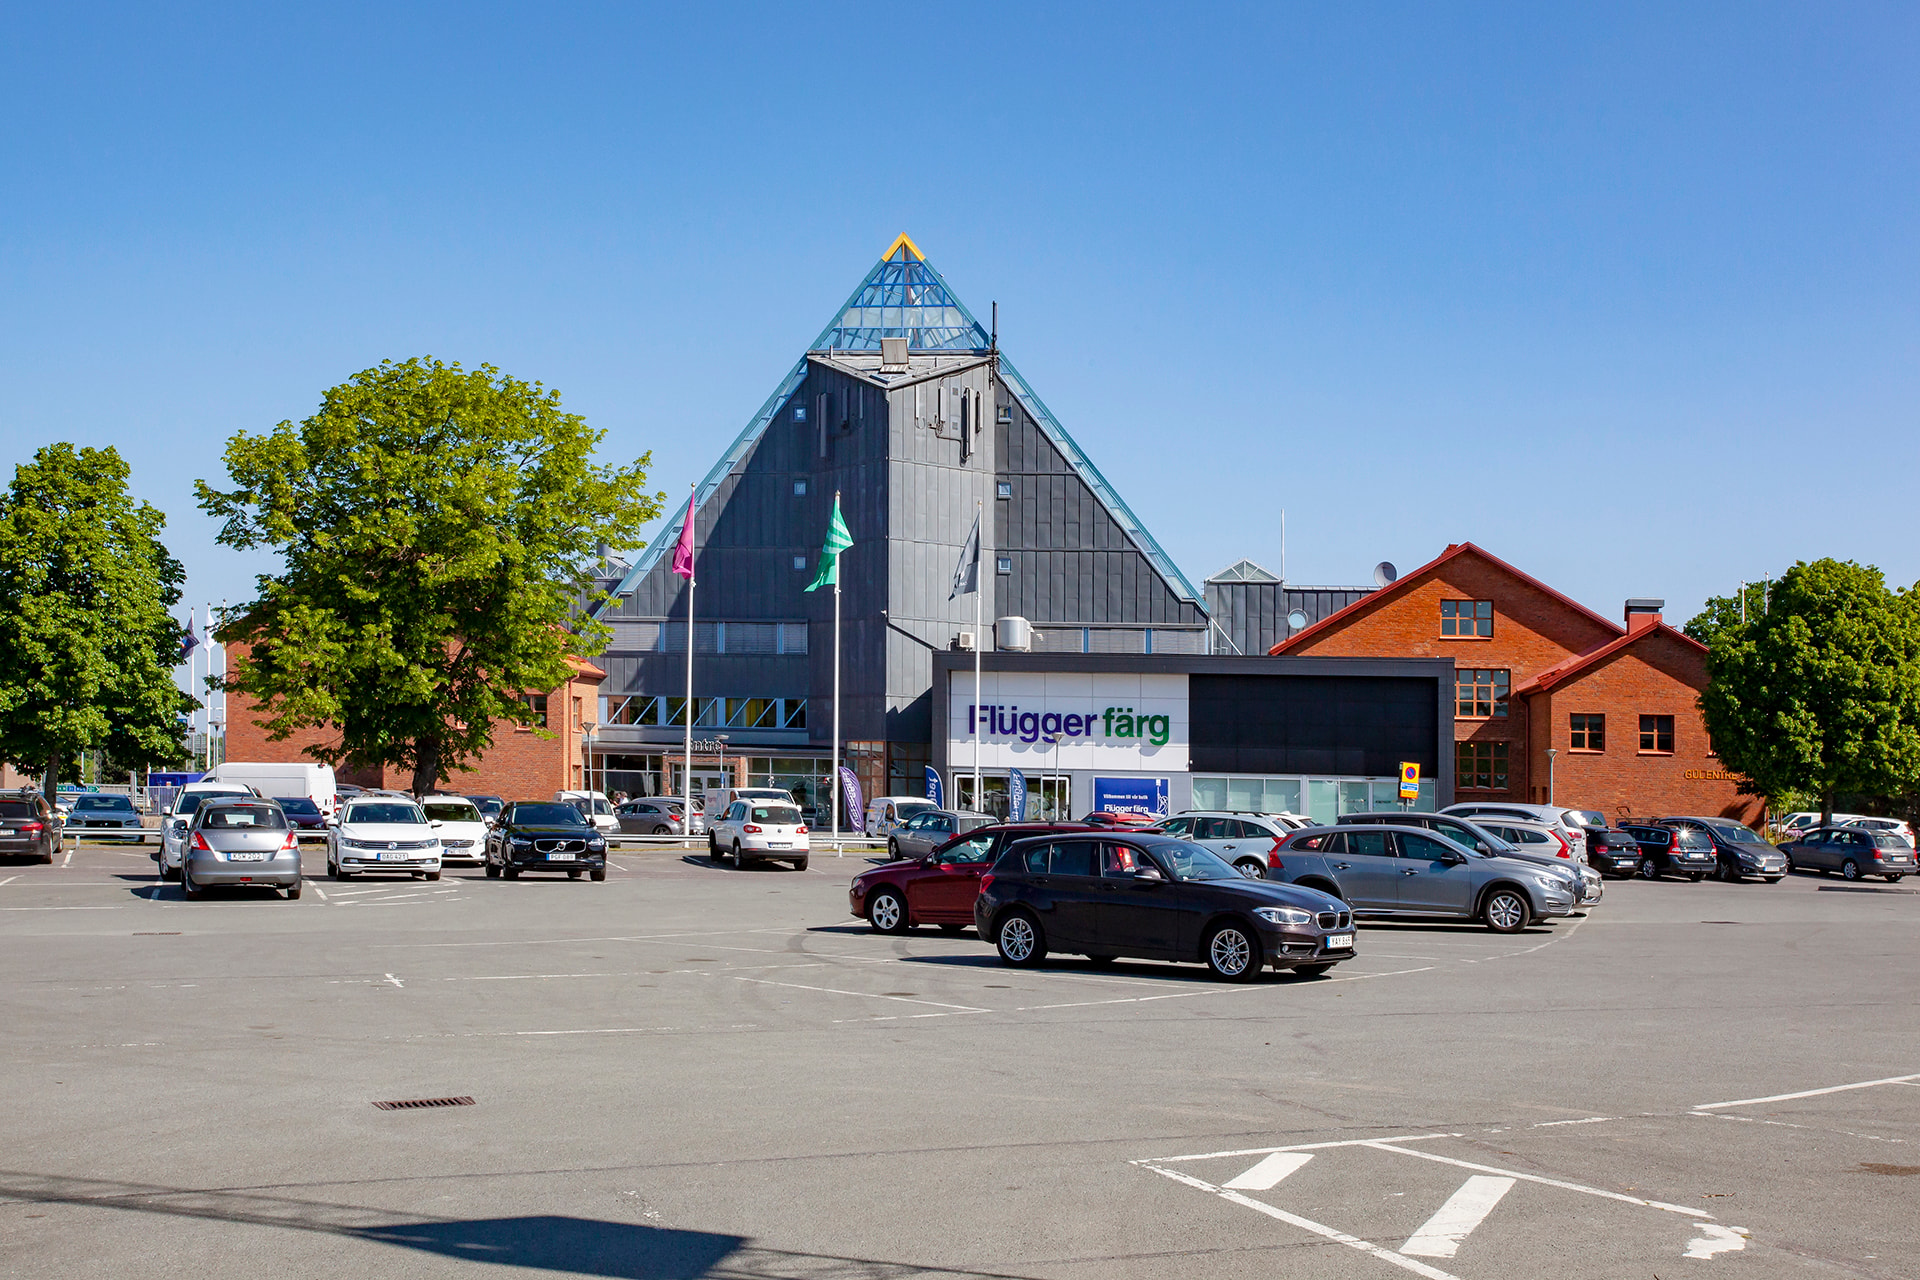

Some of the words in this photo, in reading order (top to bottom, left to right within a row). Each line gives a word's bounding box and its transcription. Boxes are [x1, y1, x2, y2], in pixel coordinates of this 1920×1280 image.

[968, 704, 1098, 744] Flügger
[1102, 706, 1170, 746] färg
[1104, 804, 1133, 813] Flügger
[1133, 804, 1149, 814] färg
